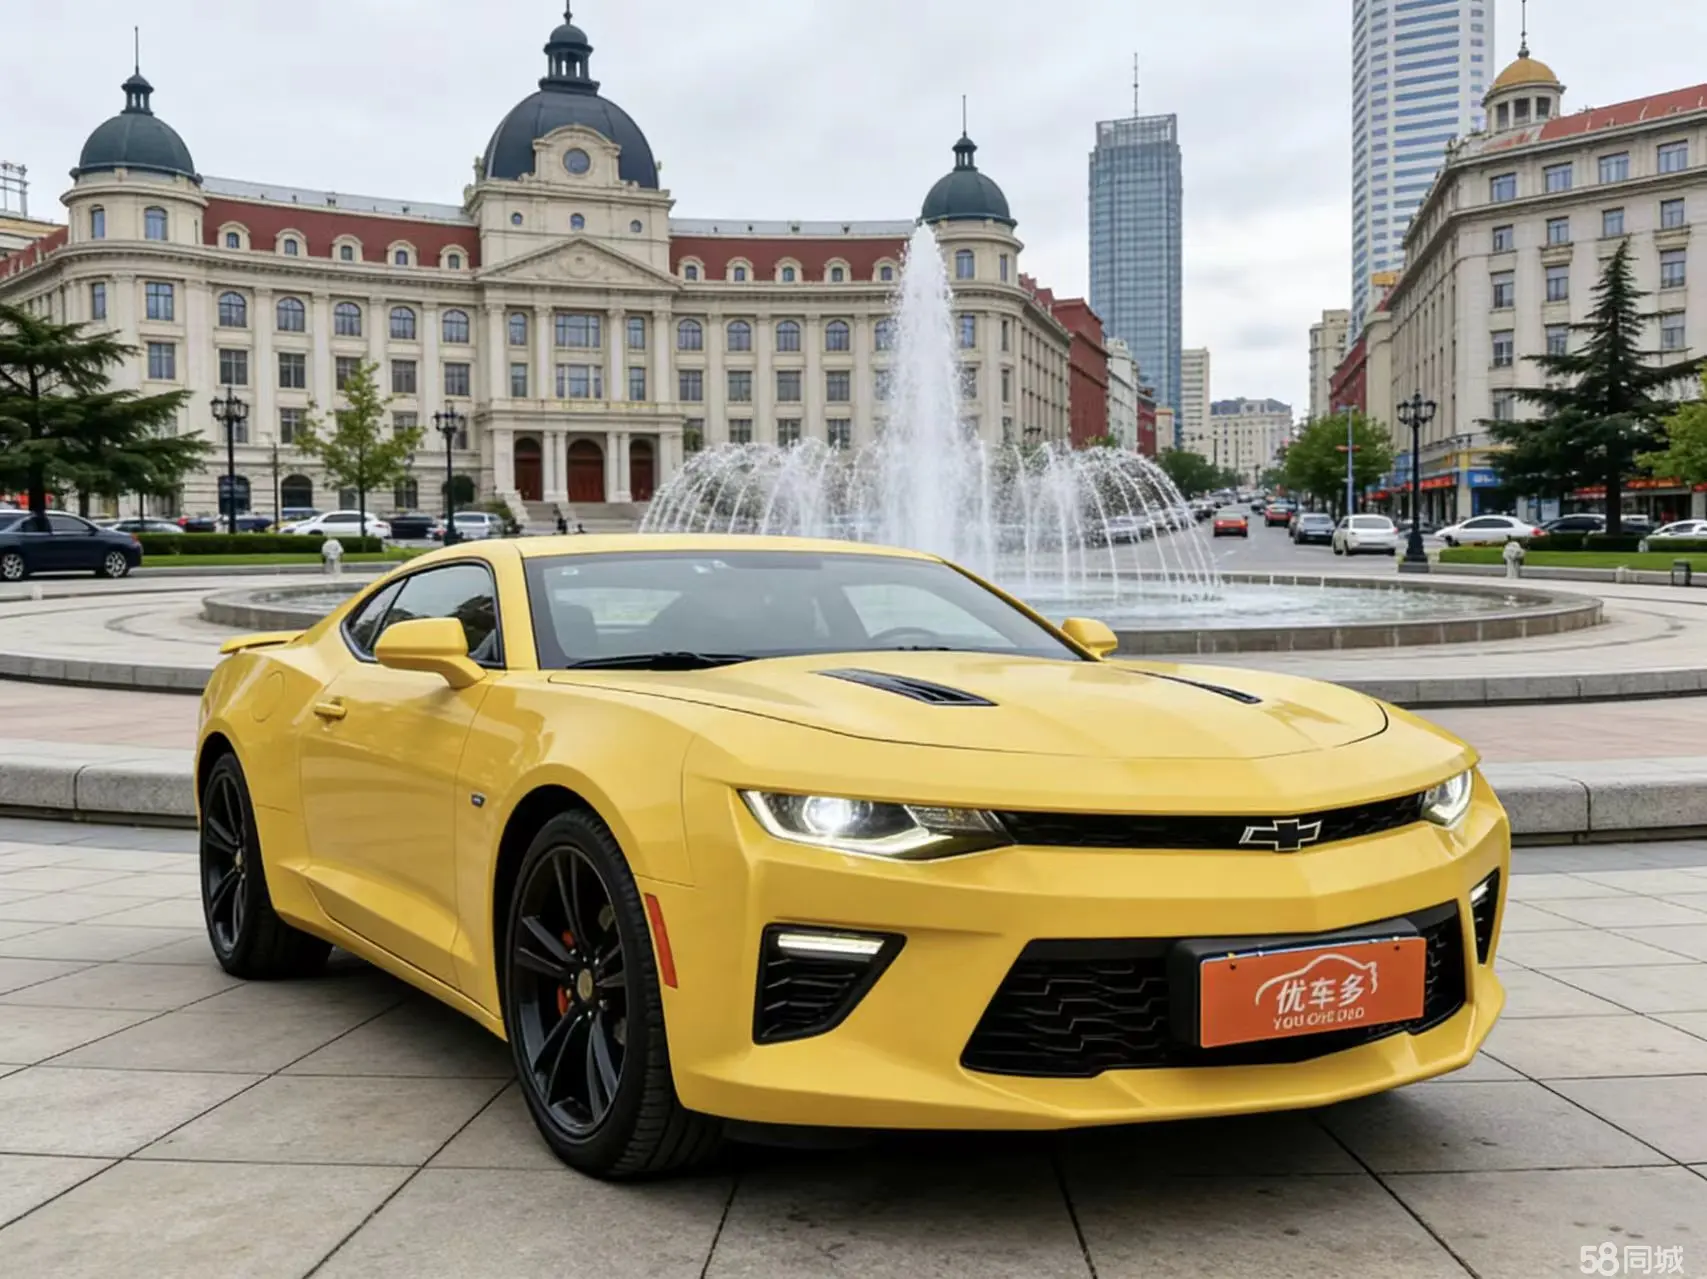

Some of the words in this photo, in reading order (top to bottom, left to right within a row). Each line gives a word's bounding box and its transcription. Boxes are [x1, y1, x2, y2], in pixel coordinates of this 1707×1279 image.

[1276, 973, 1365, 1014] 优车多
[1273, 1014, 1304, 1030] YOU
